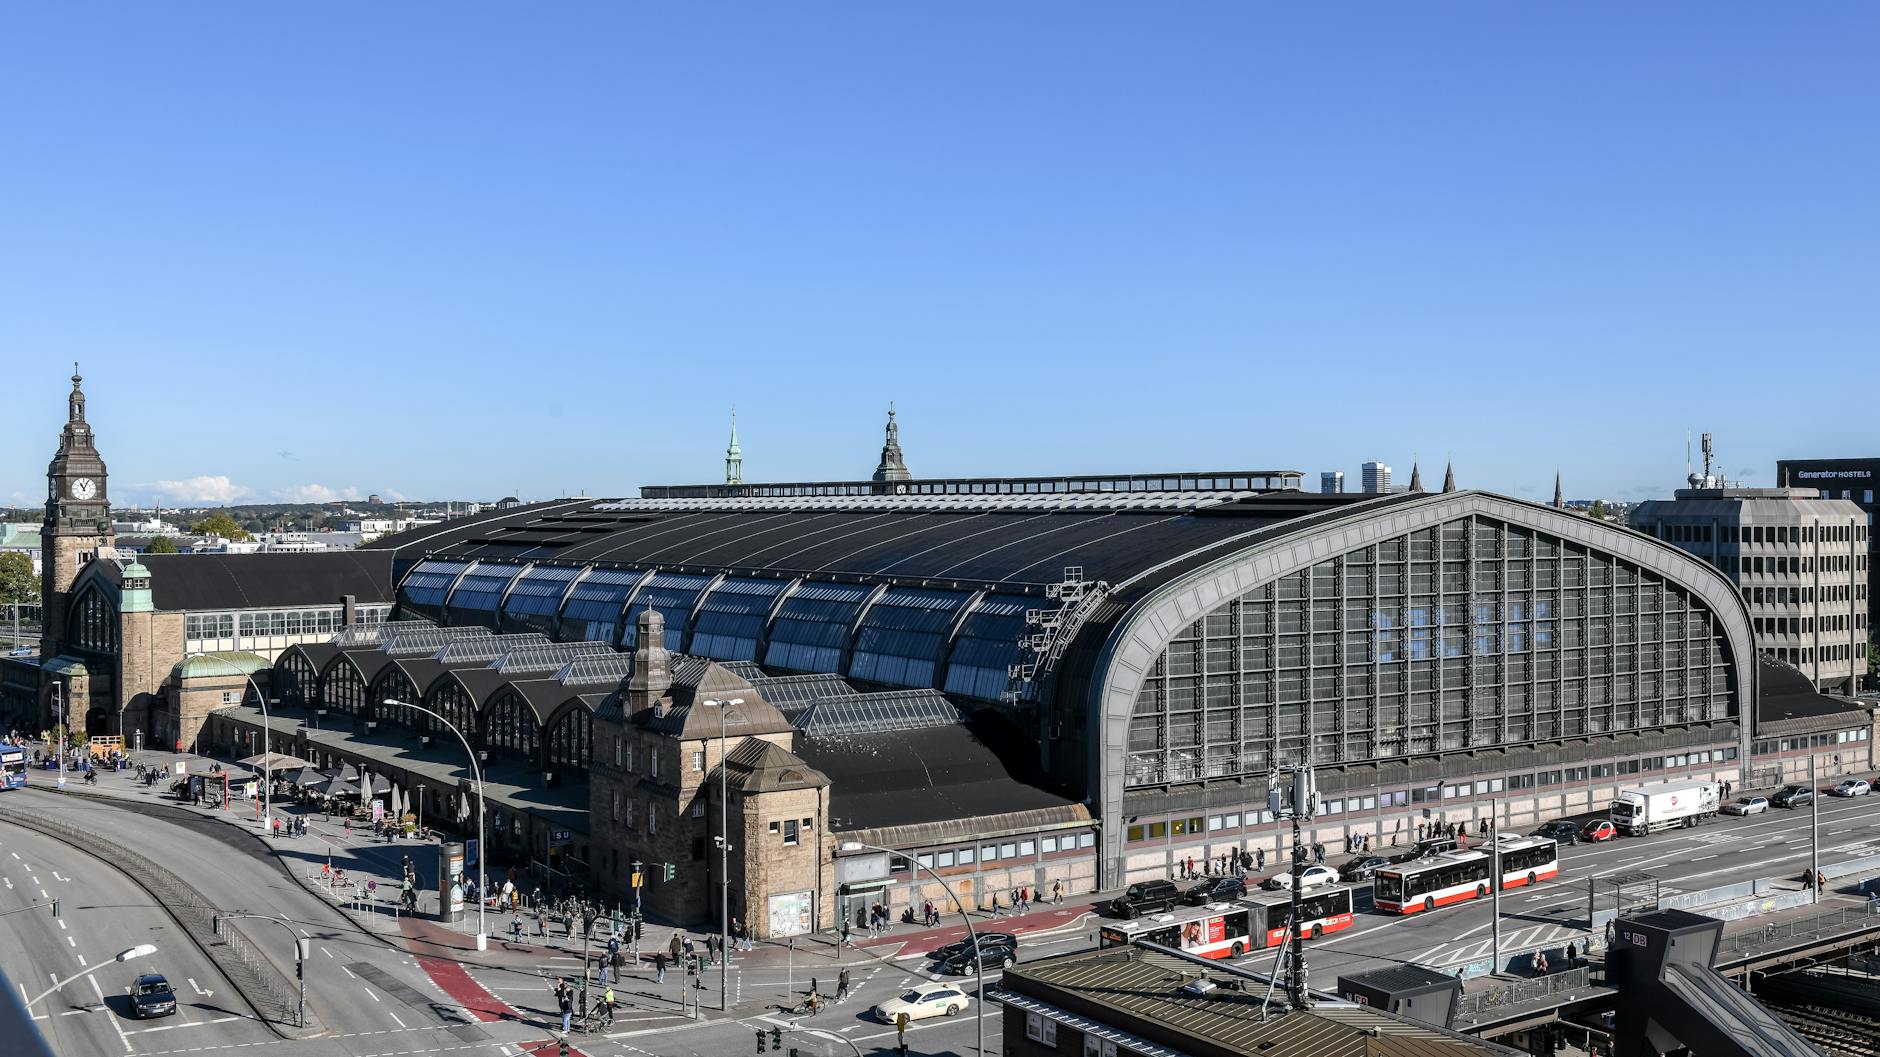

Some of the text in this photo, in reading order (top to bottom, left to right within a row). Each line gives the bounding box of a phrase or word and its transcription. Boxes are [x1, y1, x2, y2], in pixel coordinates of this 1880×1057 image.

[1798, 470, 1838, 478] Generator
[1624, 931, 1647, 947] 12 DB
